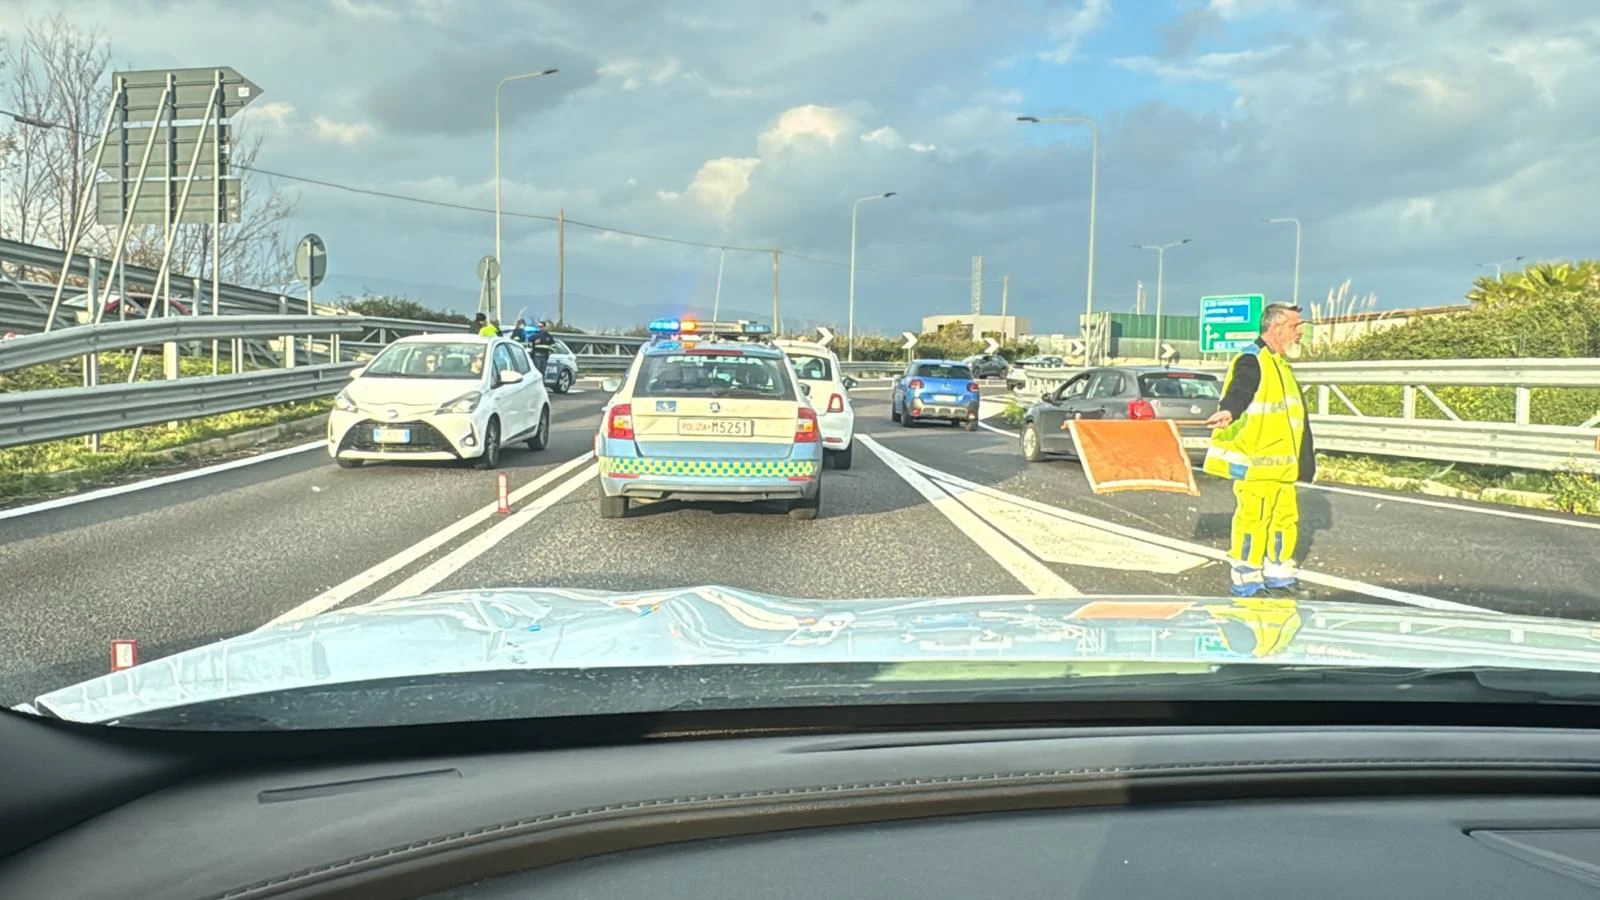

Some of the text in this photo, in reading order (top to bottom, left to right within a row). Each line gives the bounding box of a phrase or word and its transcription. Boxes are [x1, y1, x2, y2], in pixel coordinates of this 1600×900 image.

[666, 356, 763, 365] POLIZIA
[682, 421, 747, 434] POLIZIA M5251
